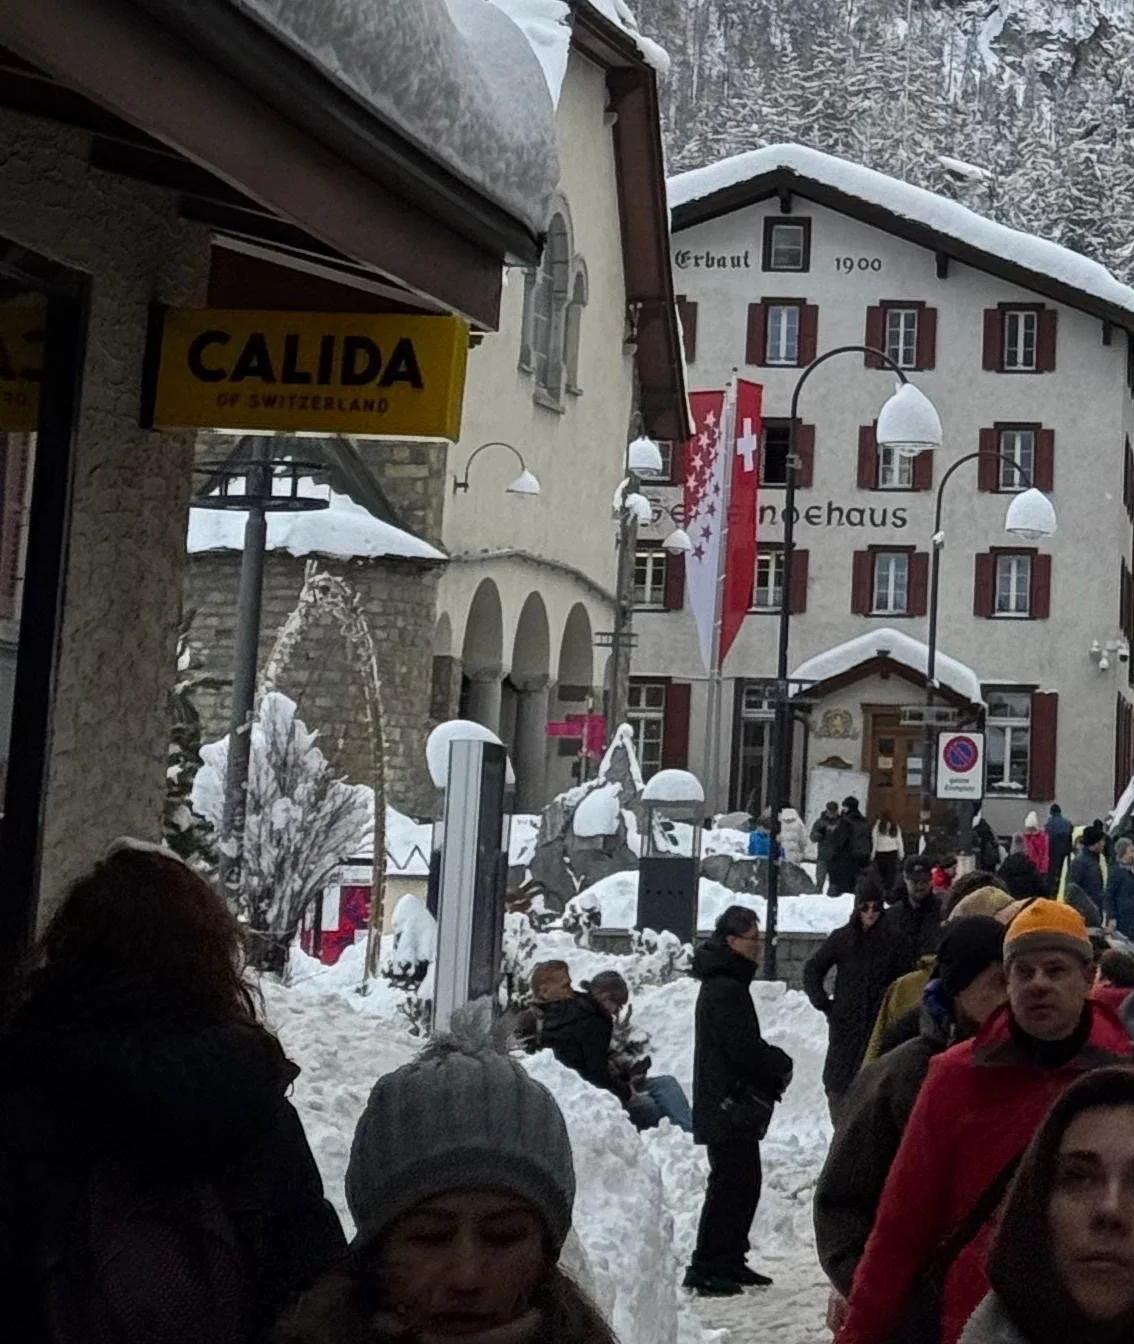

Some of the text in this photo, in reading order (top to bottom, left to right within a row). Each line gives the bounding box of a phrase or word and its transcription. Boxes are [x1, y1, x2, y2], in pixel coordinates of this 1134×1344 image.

[674, 249, 882, 274] Erbaut 1900
[187, 329, 425, 390] CALIDA
[215, 391, 390, 414] OF SWITZERLAND
